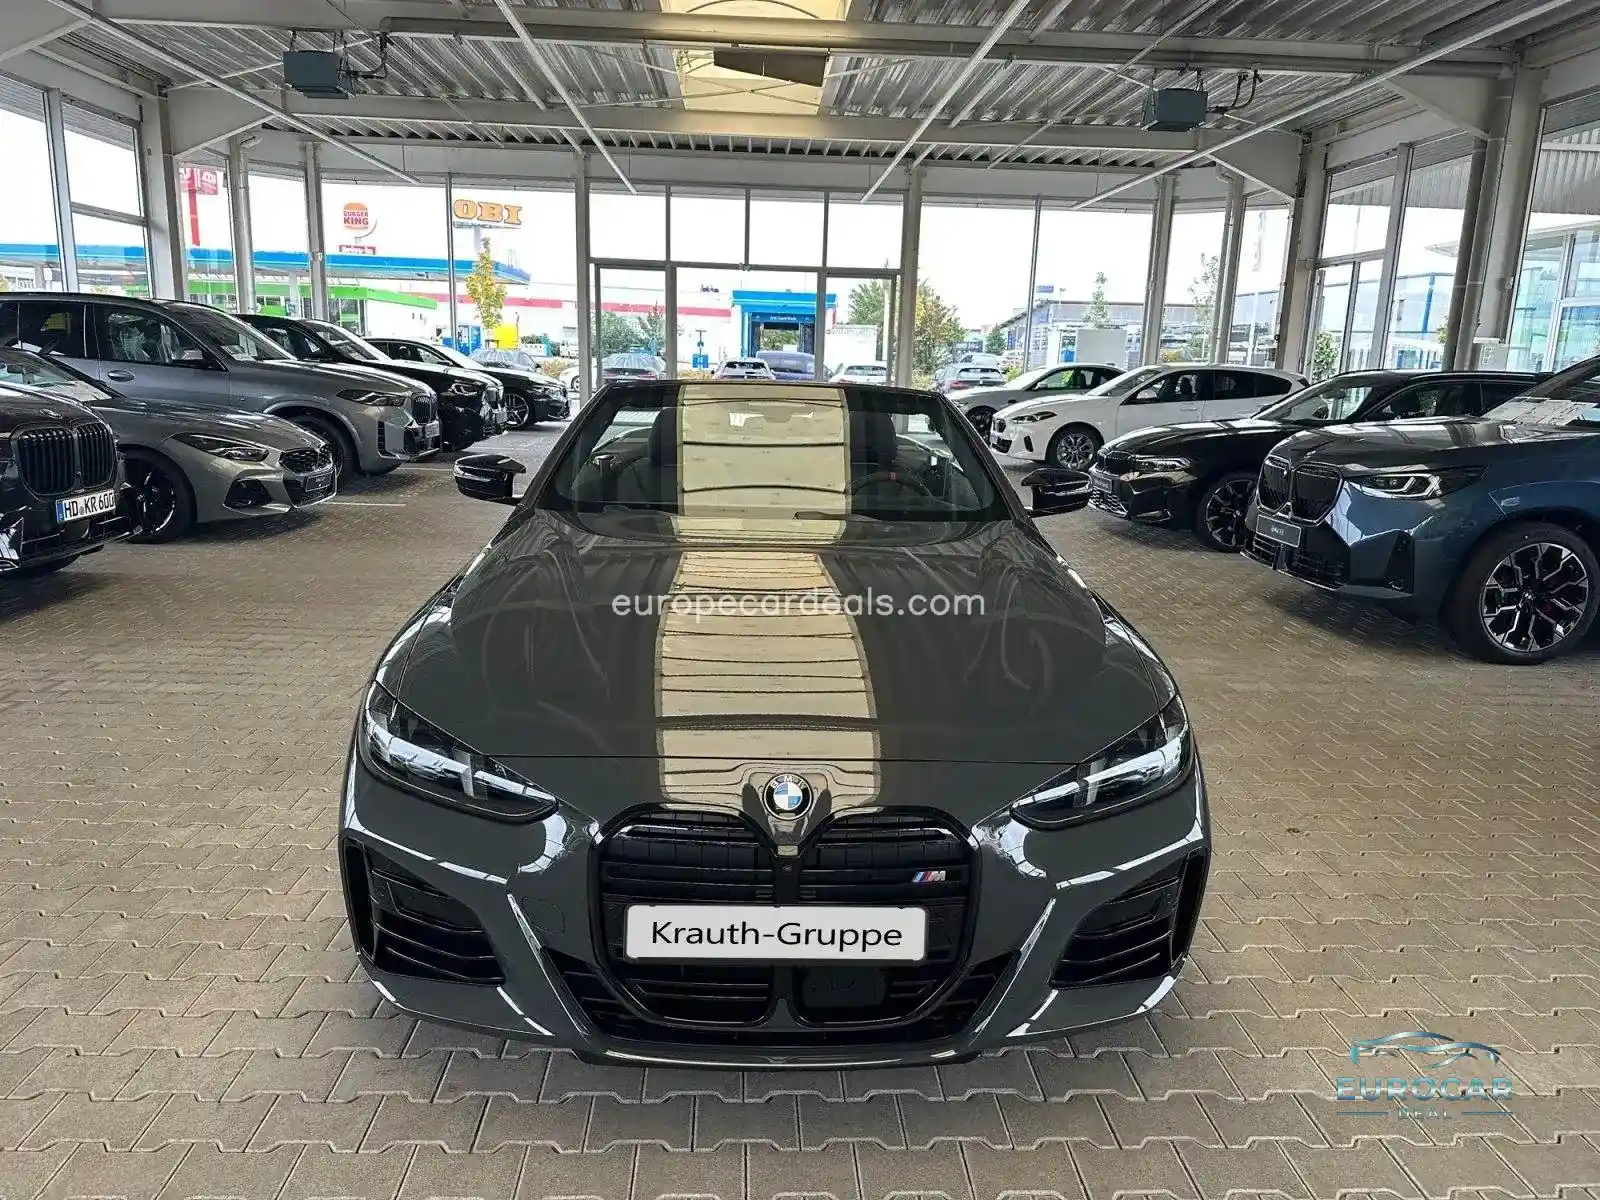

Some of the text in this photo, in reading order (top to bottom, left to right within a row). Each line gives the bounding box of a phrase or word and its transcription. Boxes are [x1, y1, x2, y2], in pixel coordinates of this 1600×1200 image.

[343, 217, 369, 225] KING
[454, 199, 522, 225] OBI
[63, 492, 115, 519] HD KR 600
[769, 774, 809, 790] BMW
[651, 921, 903, 952] Krauth-Gruppe
